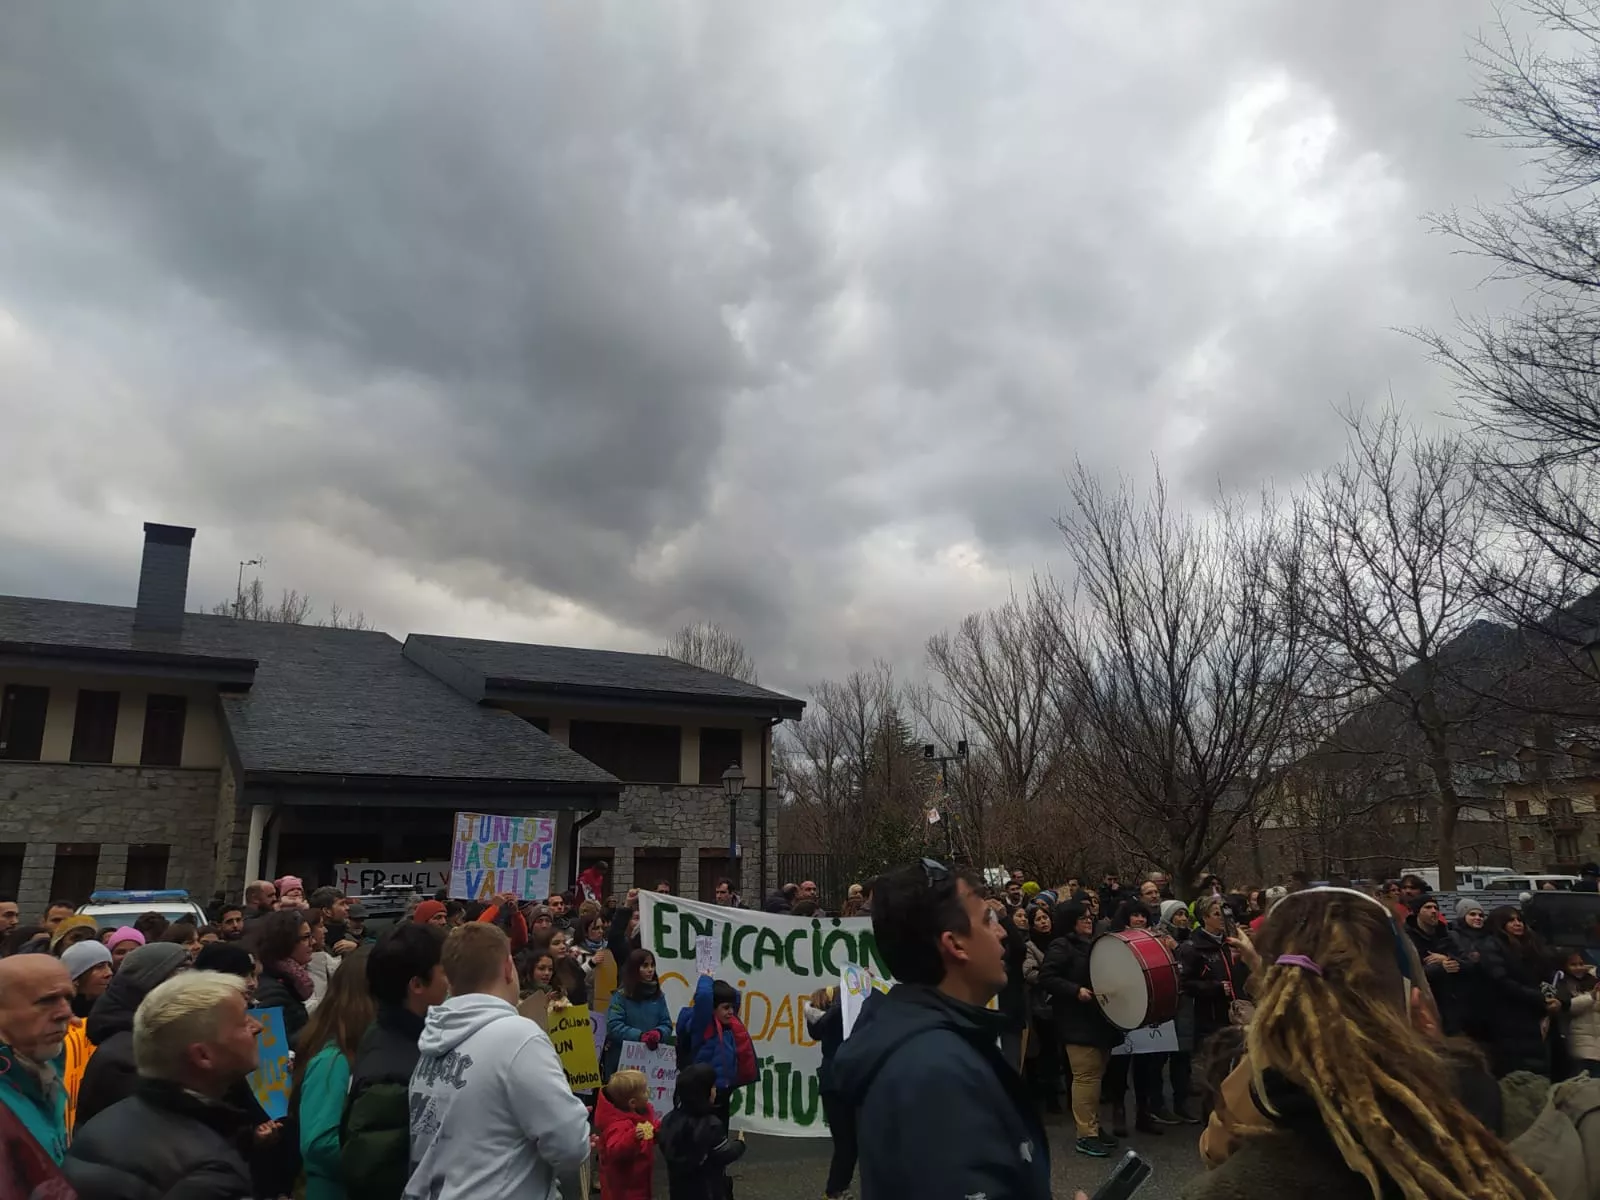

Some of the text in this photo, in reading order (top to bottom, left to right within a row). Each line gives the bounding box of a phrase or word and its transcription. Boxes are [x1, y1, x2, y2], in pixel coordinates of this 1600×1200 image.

[461, 814, 553, 843] JUNTOS
[453, 841, 553, 871] HACEMOS
[465, 868, 540, 900] VALLE
